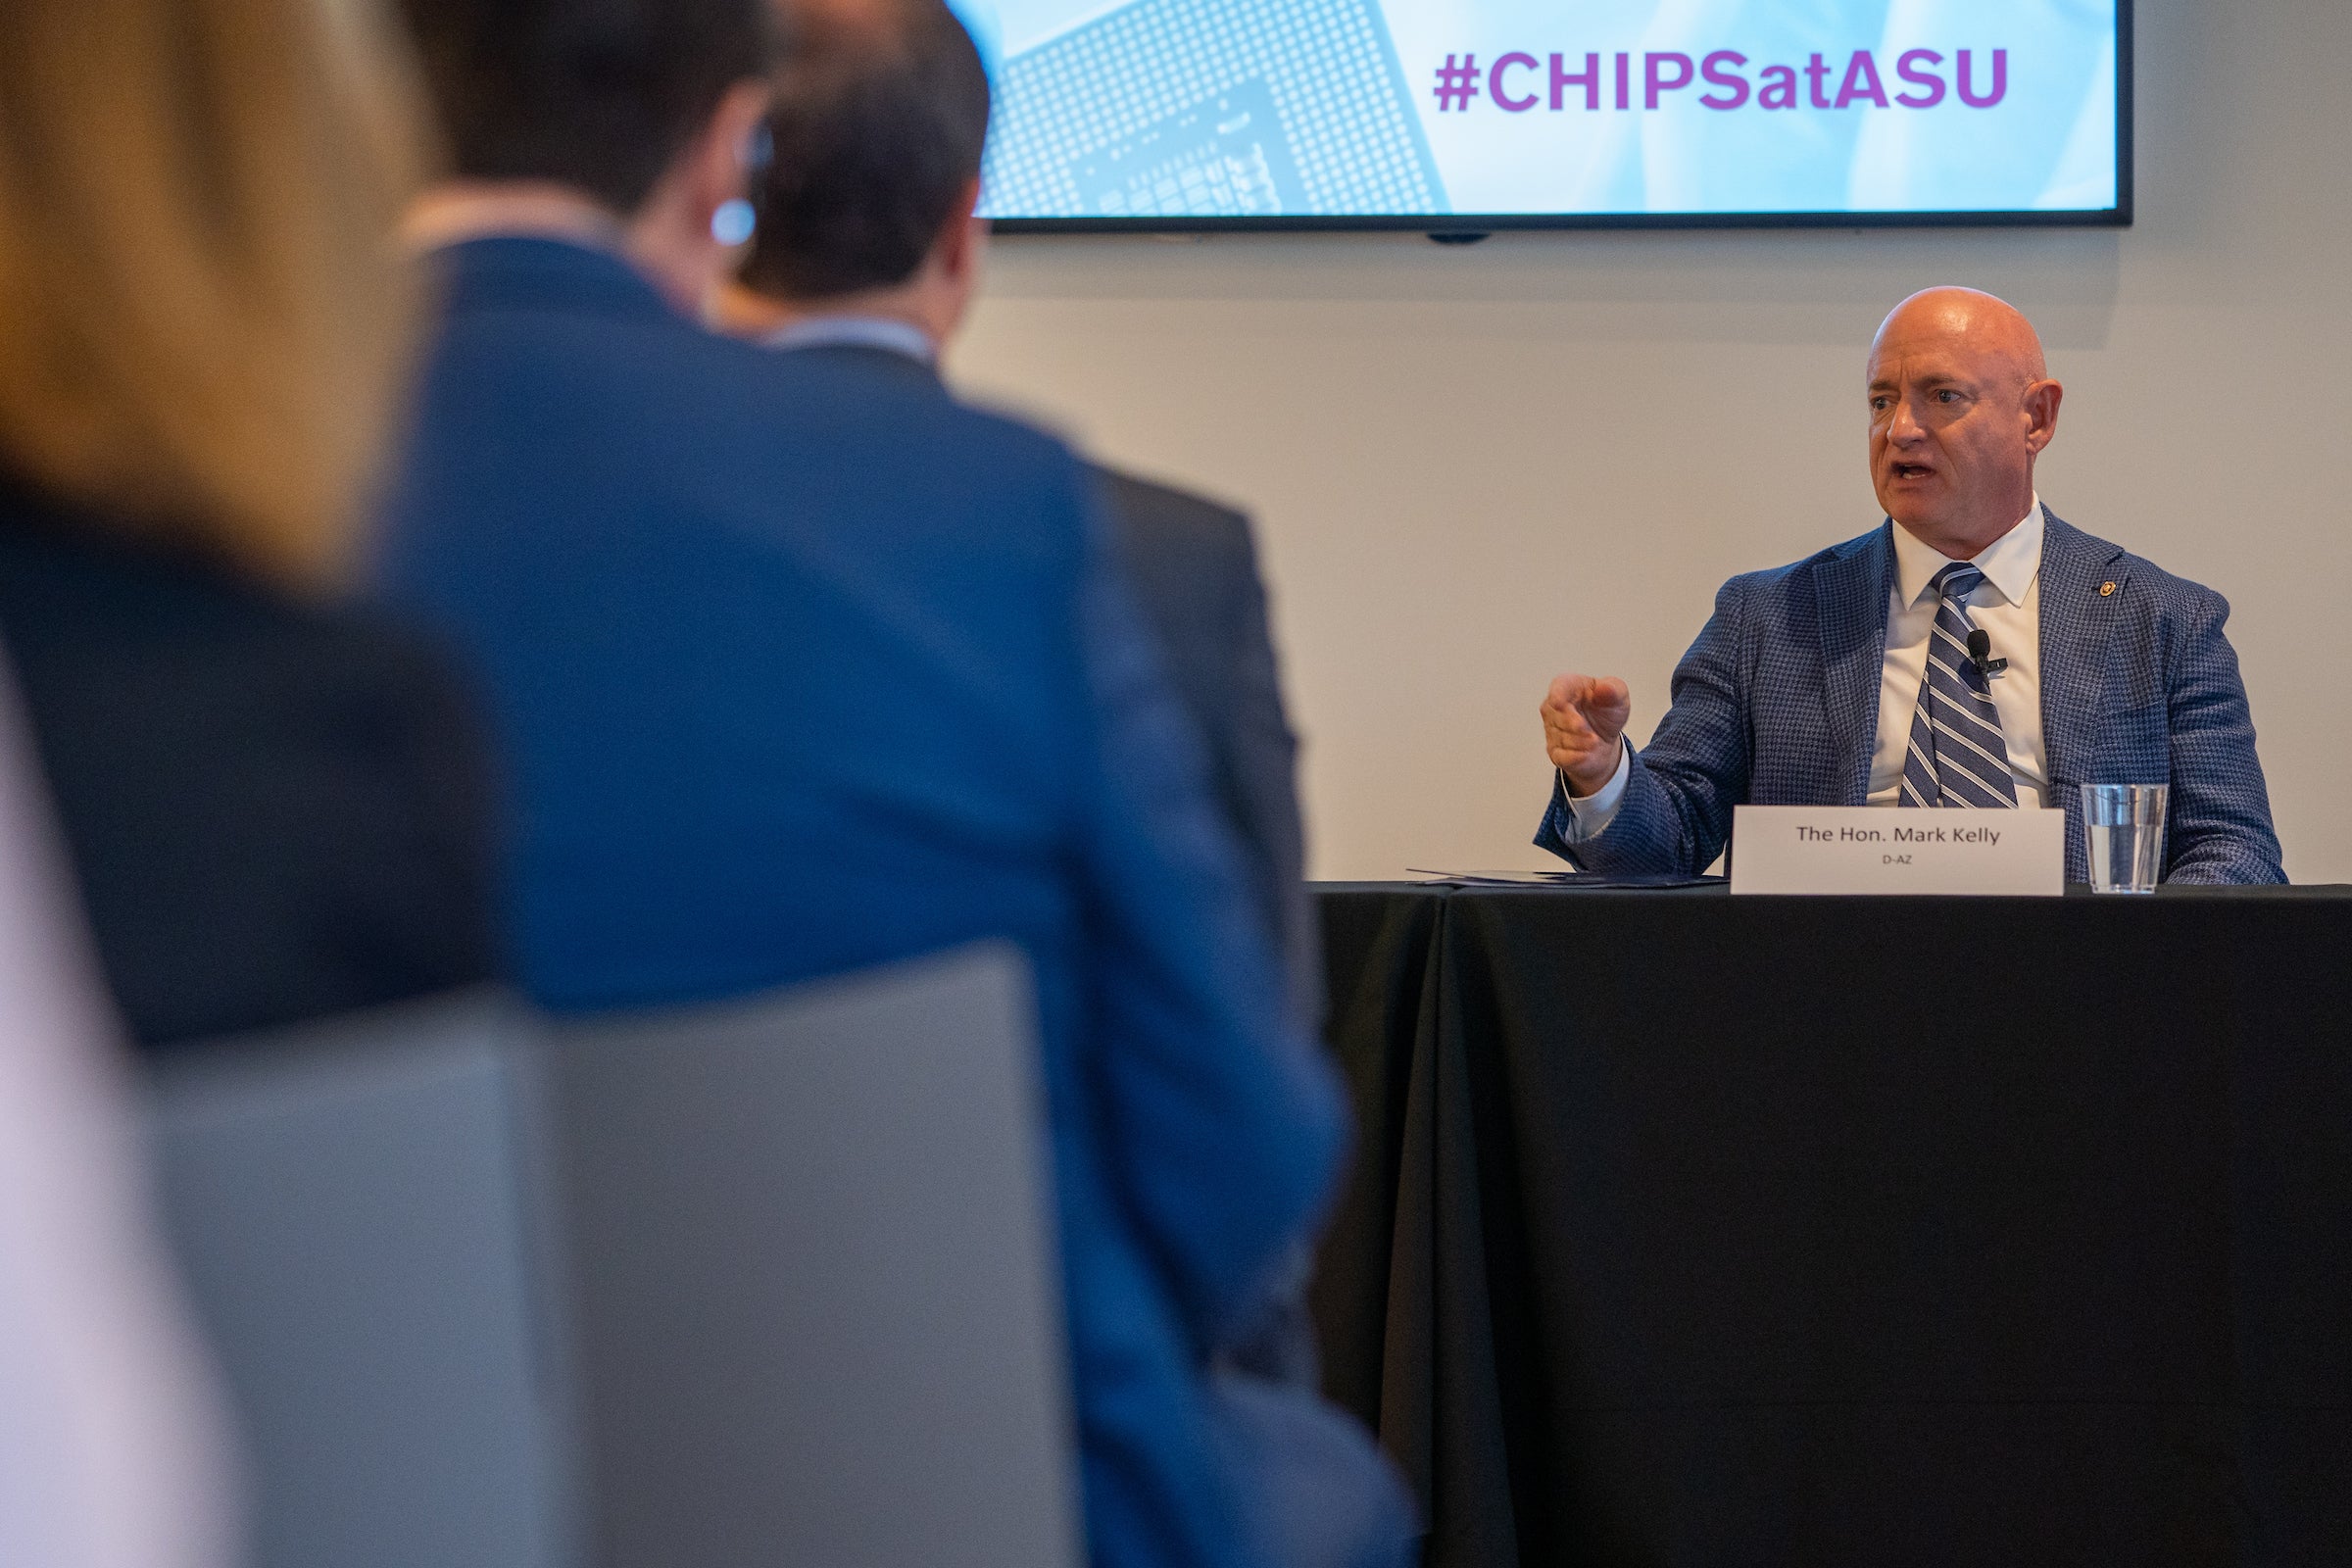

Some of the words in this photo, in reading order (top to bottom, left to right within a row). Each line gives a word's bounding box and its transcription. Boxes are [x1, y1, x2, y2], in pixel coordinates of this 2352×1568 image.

[1433, 49, 2008, 113] #CHIPSatASU
[1795, 826, 1834, 842] The
[1839, 826, 1886, 843] Hon.
[1893, 827, 1946, 843] Mark
[1952, 827, 2001, 847] Kelly
[1882, 855, 1913, 864] D-AZ
